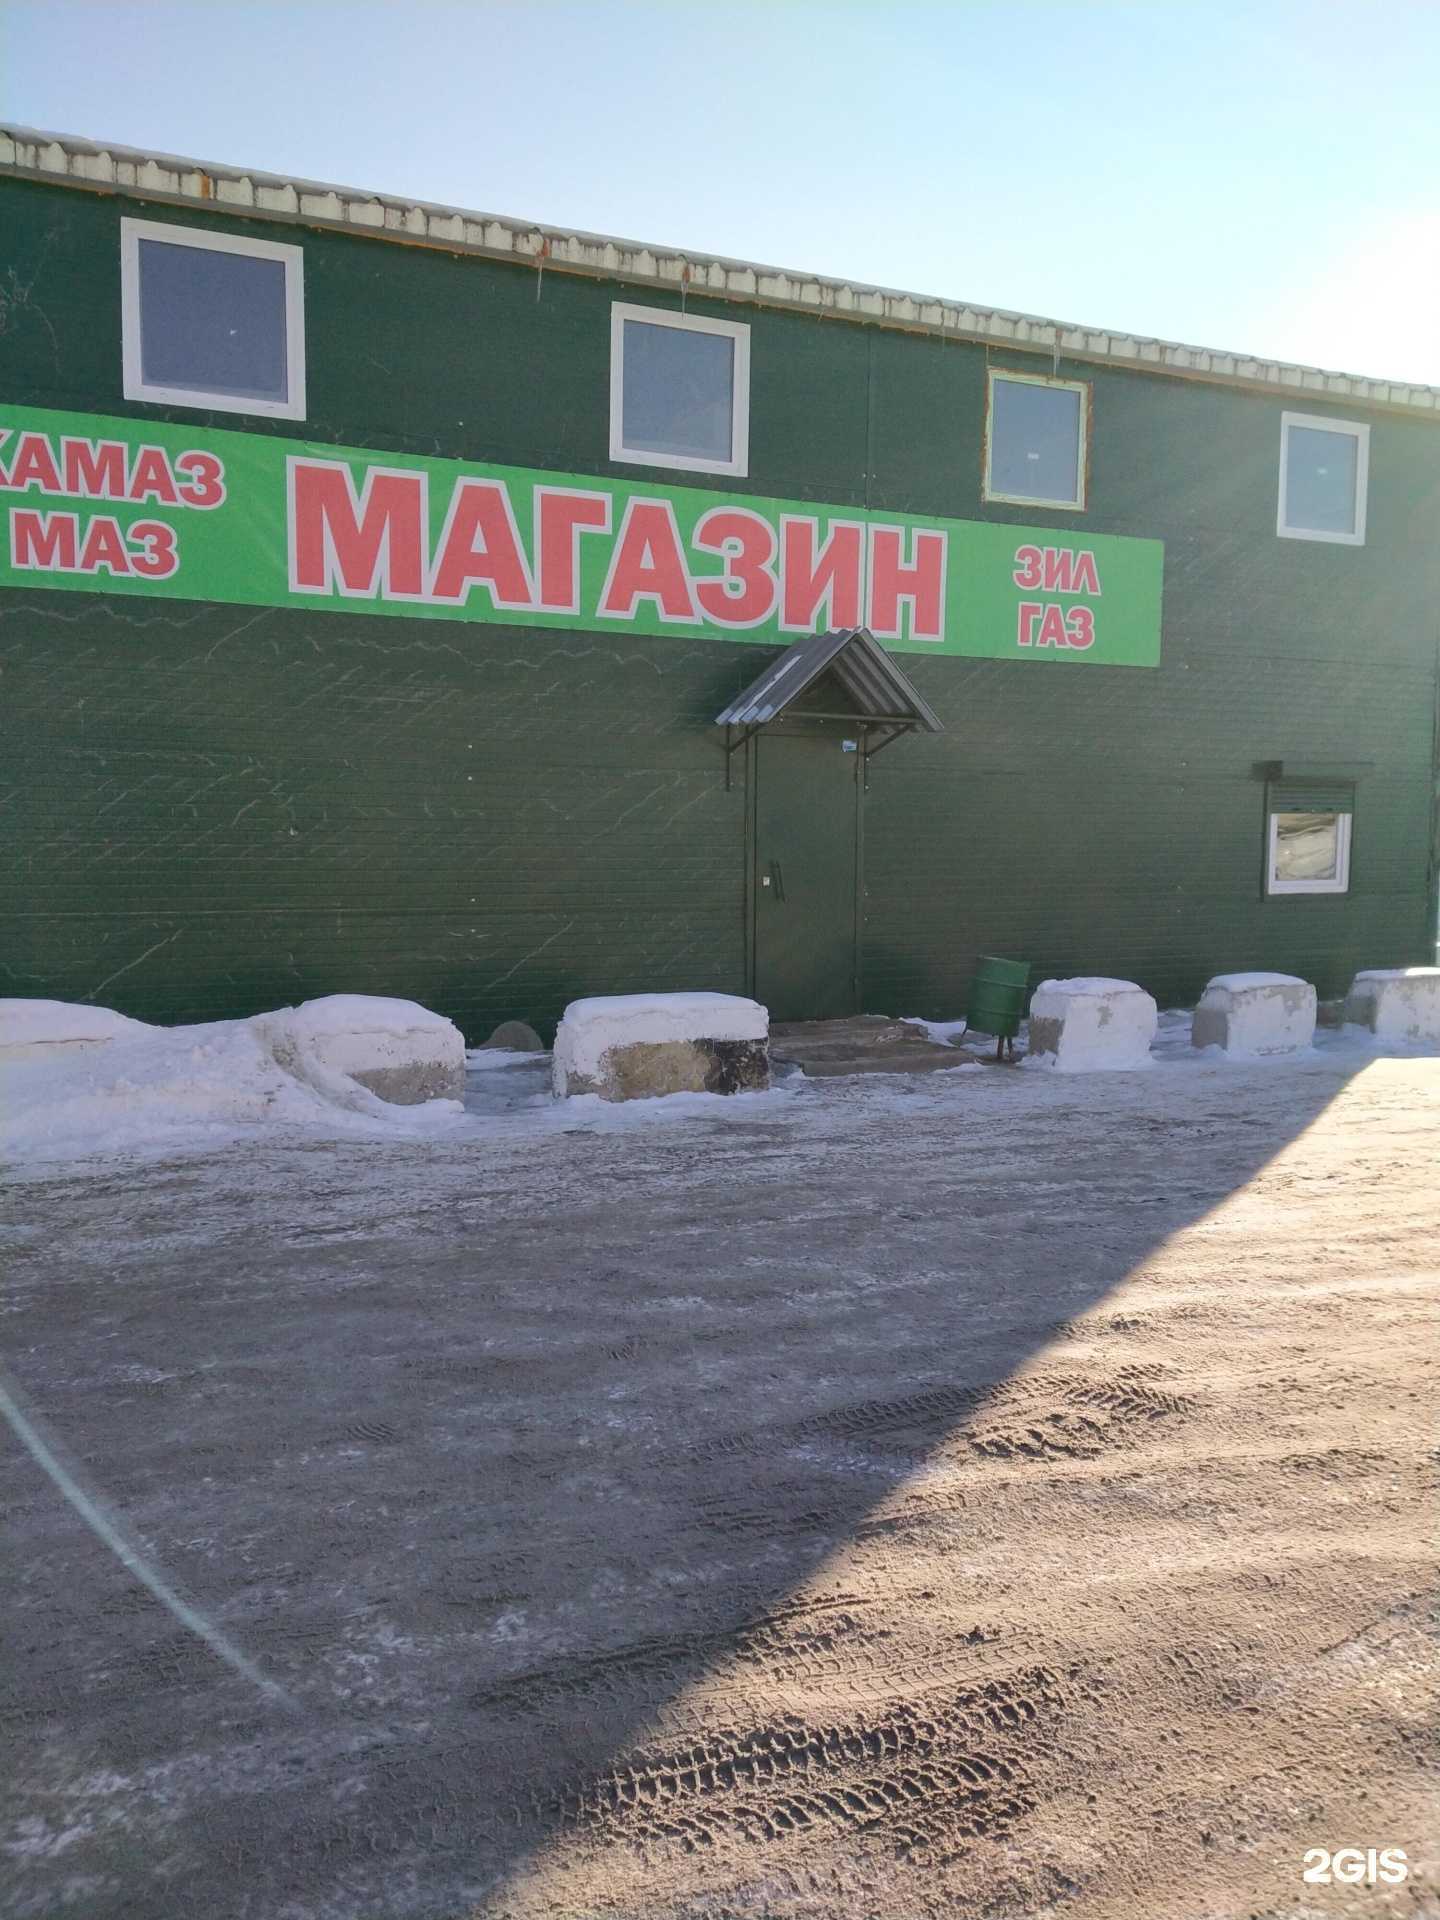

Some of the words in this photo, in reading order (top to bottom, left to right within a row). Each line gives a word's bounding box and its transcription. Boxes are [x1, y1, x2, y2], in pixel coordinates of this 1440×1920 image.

[0, 429, 226, 510] АМАЗ
[9, 508, 180, 580] МАЗ
[286, 455, 948, 642] МАГАЗИН
[1013, 544, 1101, 596] ЗИЛ
[1017, 601, 1095, 650] ГАЗ
